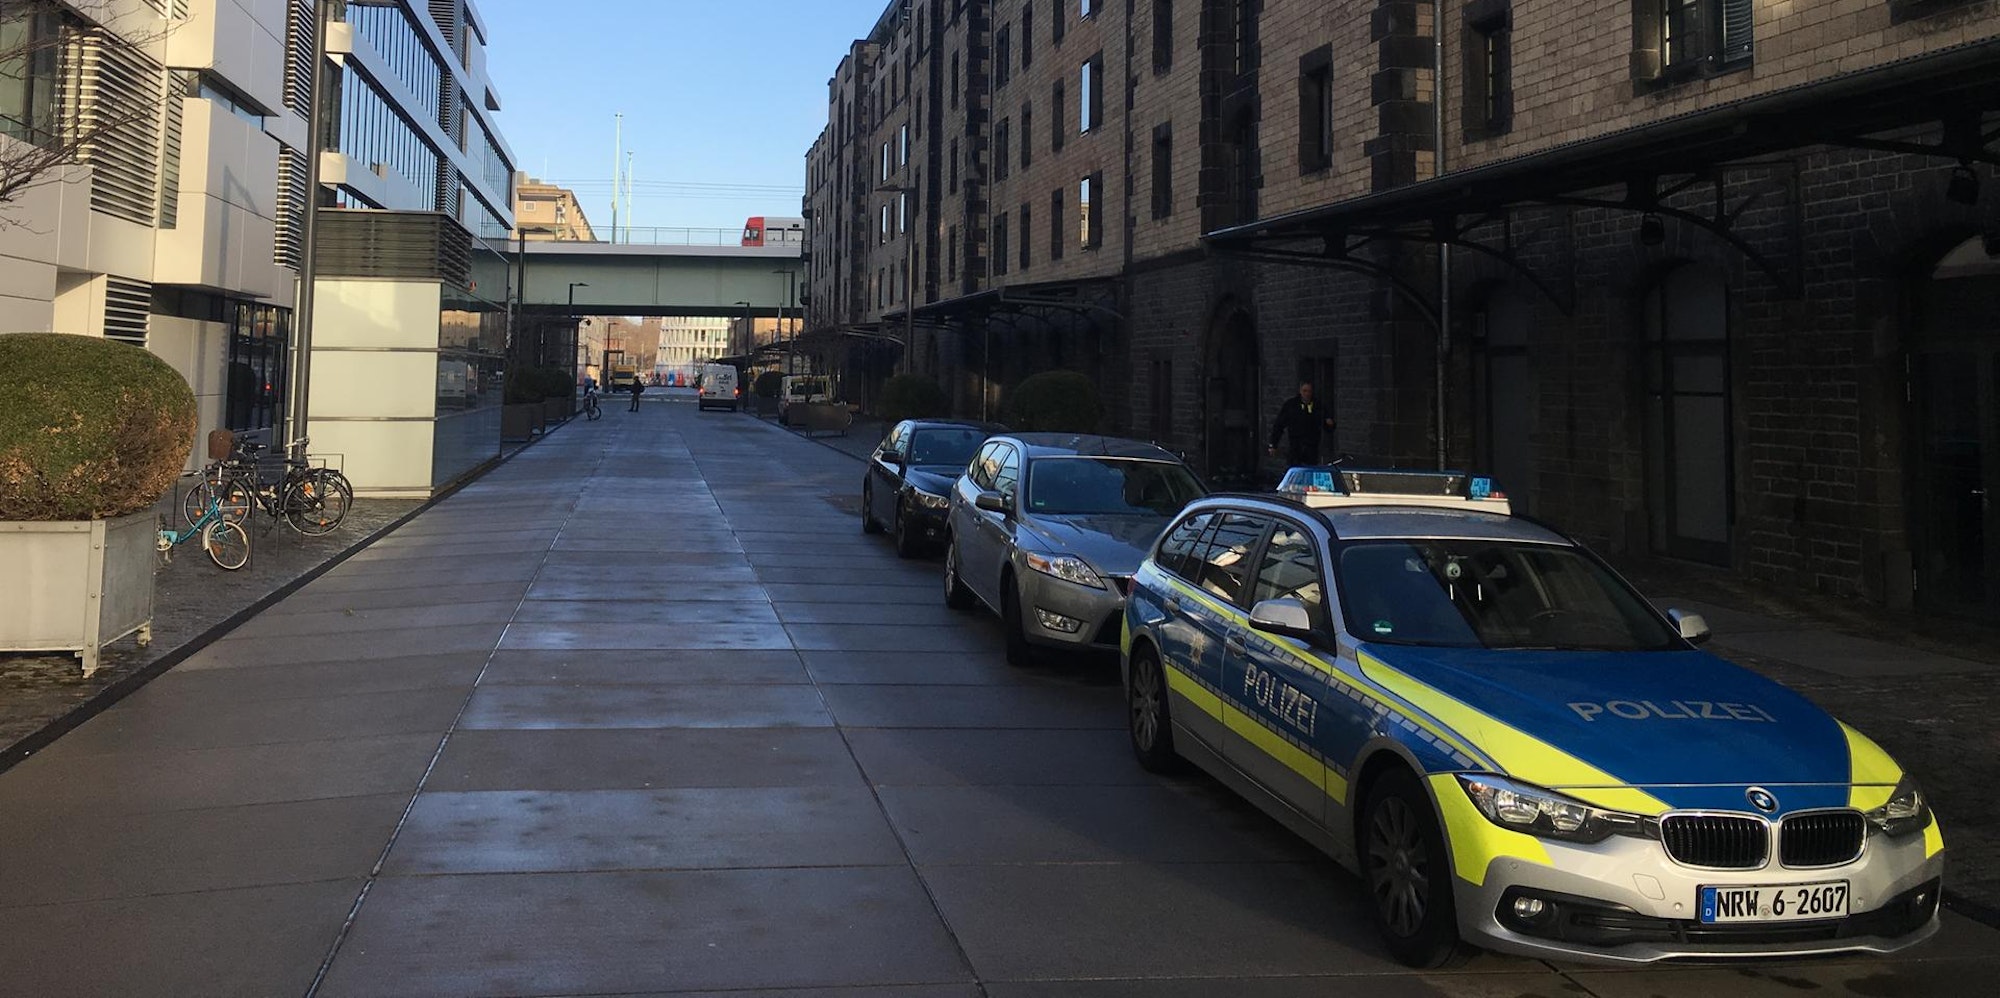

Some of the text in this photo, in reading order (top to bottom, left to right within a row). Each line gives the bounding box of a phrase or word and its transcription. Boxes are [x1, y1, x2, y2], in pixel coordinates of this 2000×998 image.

[1244, 662, 1318, 738] POLIZEI
[1566, 700, 1777, 722] POLIZEI
[1705, 908, 1712, 916] D
[1717, 886, 1846, 917] NRW 6-2607
